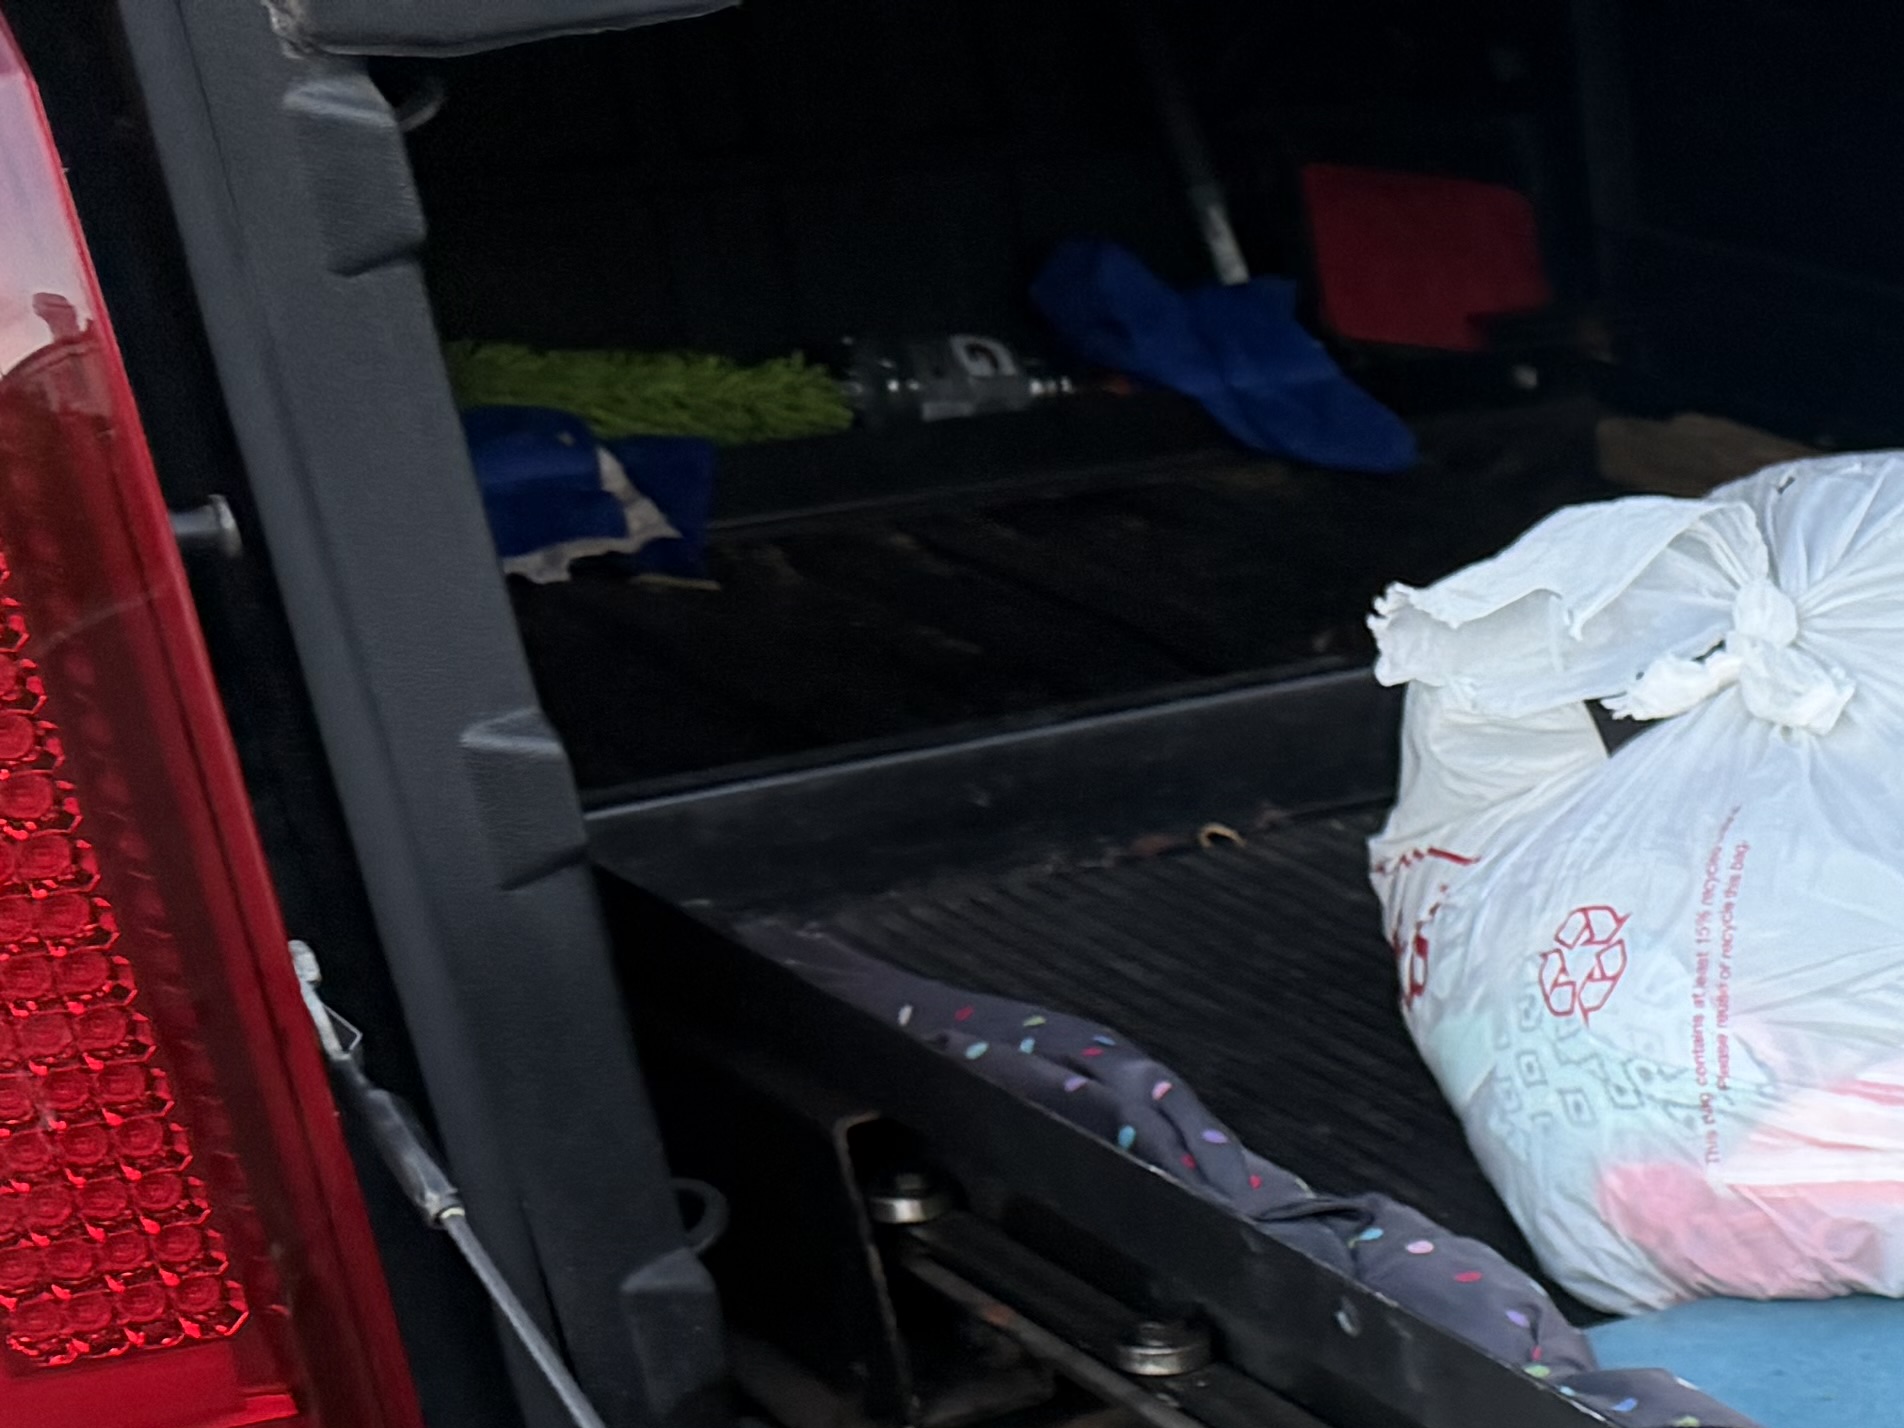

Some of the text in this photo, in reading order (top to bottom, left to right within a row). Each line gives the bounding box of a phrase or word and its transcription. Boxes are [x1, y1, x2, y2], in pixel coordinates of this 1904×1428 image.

[1723, 873, 1743, 899] this
[1695, 910, 1712, 944] 15%
[1720, 902, 1738, 960] recycle
[1693, 951, 1710, 989] least
[1719, 962, 1732, 981] or
[1691, 992, 1706, 1009] at
[1692, 1013, 1708, 1087] contains
[1716, 1033, 1731, 1091] Please
